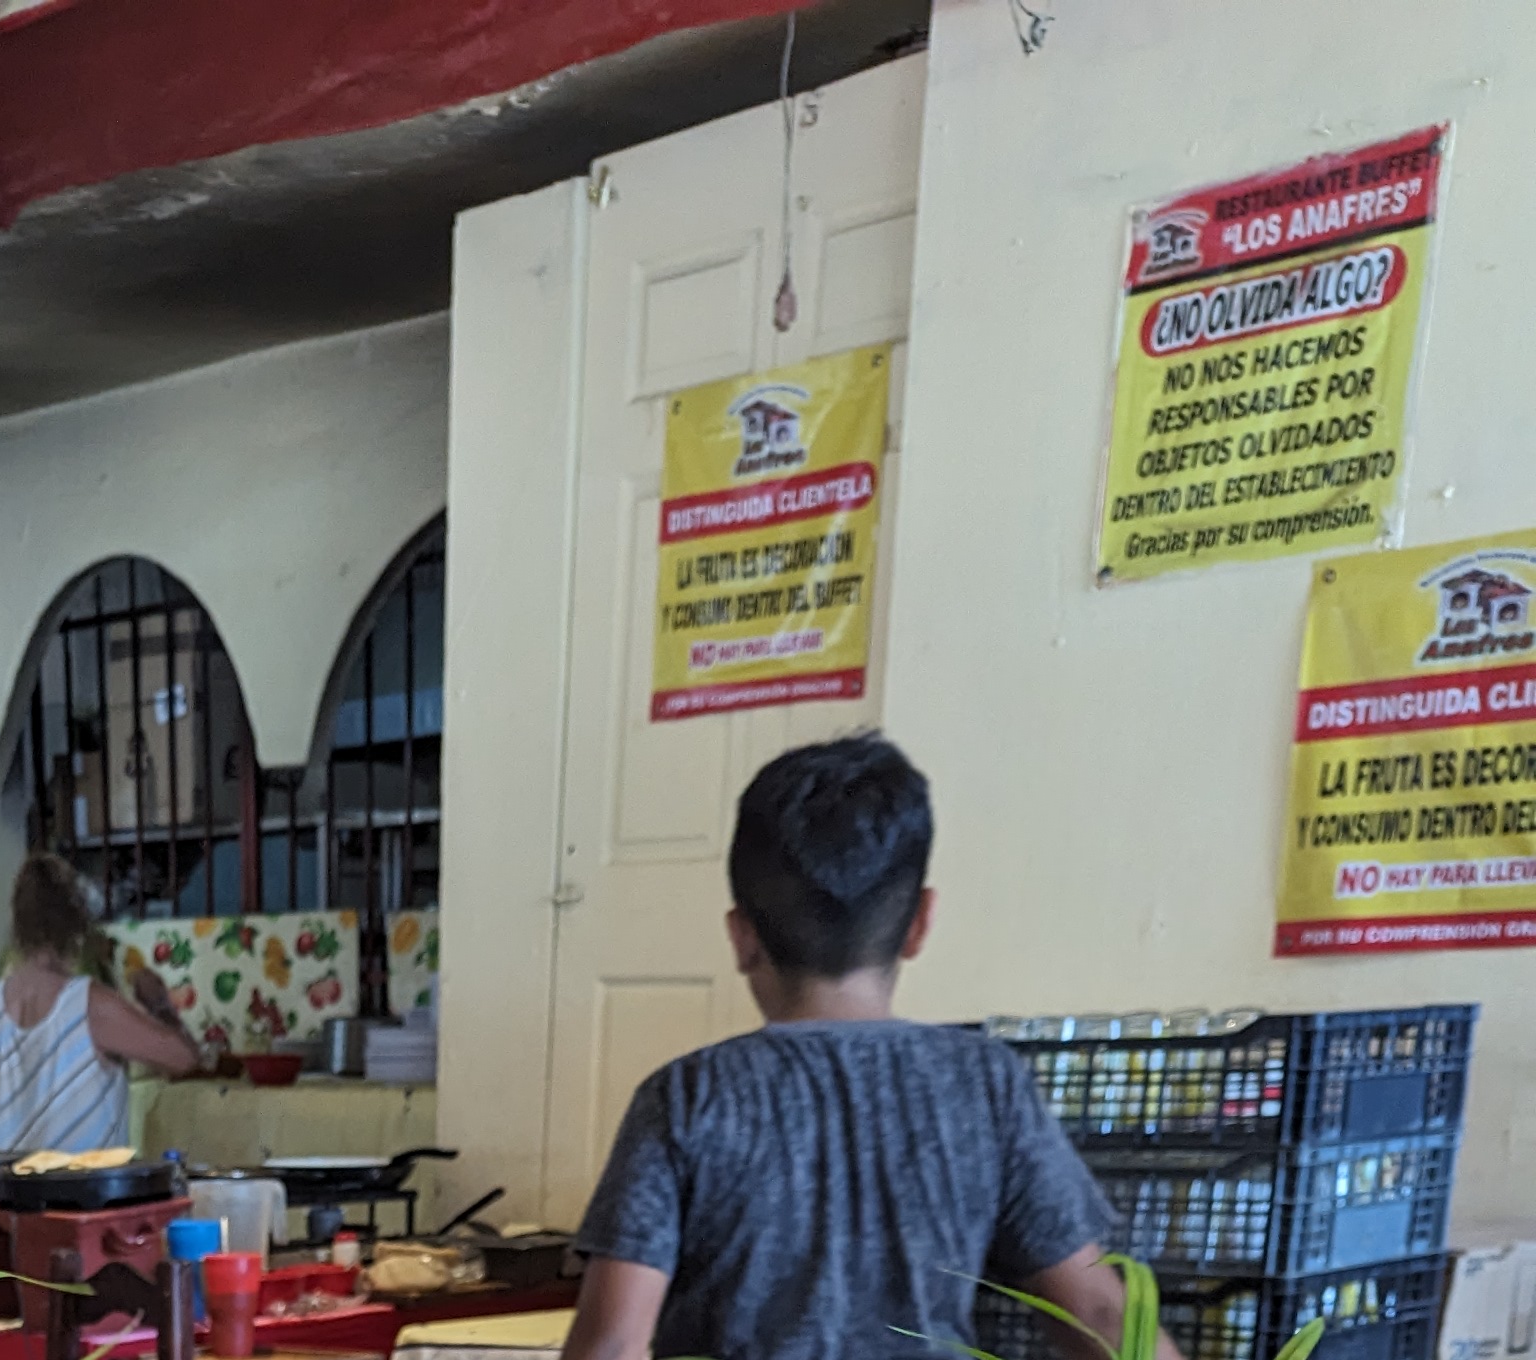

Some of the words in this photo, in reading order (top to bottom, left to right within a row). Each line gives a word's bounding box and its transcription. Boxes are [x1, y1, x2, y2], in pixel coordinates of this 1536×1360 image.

[1156, 295, 1204, 347] ¿NO
[1207, 276, 1298, 334] OLVIDA
[1301, 249, 1390, 312] ALGO?
[1162, 363, 1196, 395] NO
[1200, 351, 1248, 386] NOS
[1251, 326, 1368, 376] HACEMOS
[1147, 377, 1320, 437] RESPONSABLES
[1324, 366, 1376, 402] POR
[1136, 437, 1234, 479] OBJETOS
[1238, 409, 1378, 461] OLVIDADOS
[667, 493, 774, 534] DISTINGUIDA
[778, 474, 873, 514] CLIENTELA
[1110, 487, 1182, 522] DENTRO
[1183, 480, 1218, 512] DEL
[1222, 449, 1397, 505] ESTABLECIMIENTO
[1124, 531, 1190, 559] Gracias
[1193, 526, 1225, 558] por
[1227, 522, 1250, 546] su
[1308, 686, 1482, 730] DISTINGUIDA
[1319, 760, 1348, 798] LA
[1352, 753, 1424, 797] FRUTA
[1430, 749, 1458, 790] ES
[1296, 814, 1311, 850] Y
[1311, 808, 1413, 848] CONSUMO
[1416, 801, 1498, 843] DENTRO
[1336, 865, 1382, 894] NO
[1383, 868, 1426, 889] HAY
[1429, 863, 1480, 886] PARA
